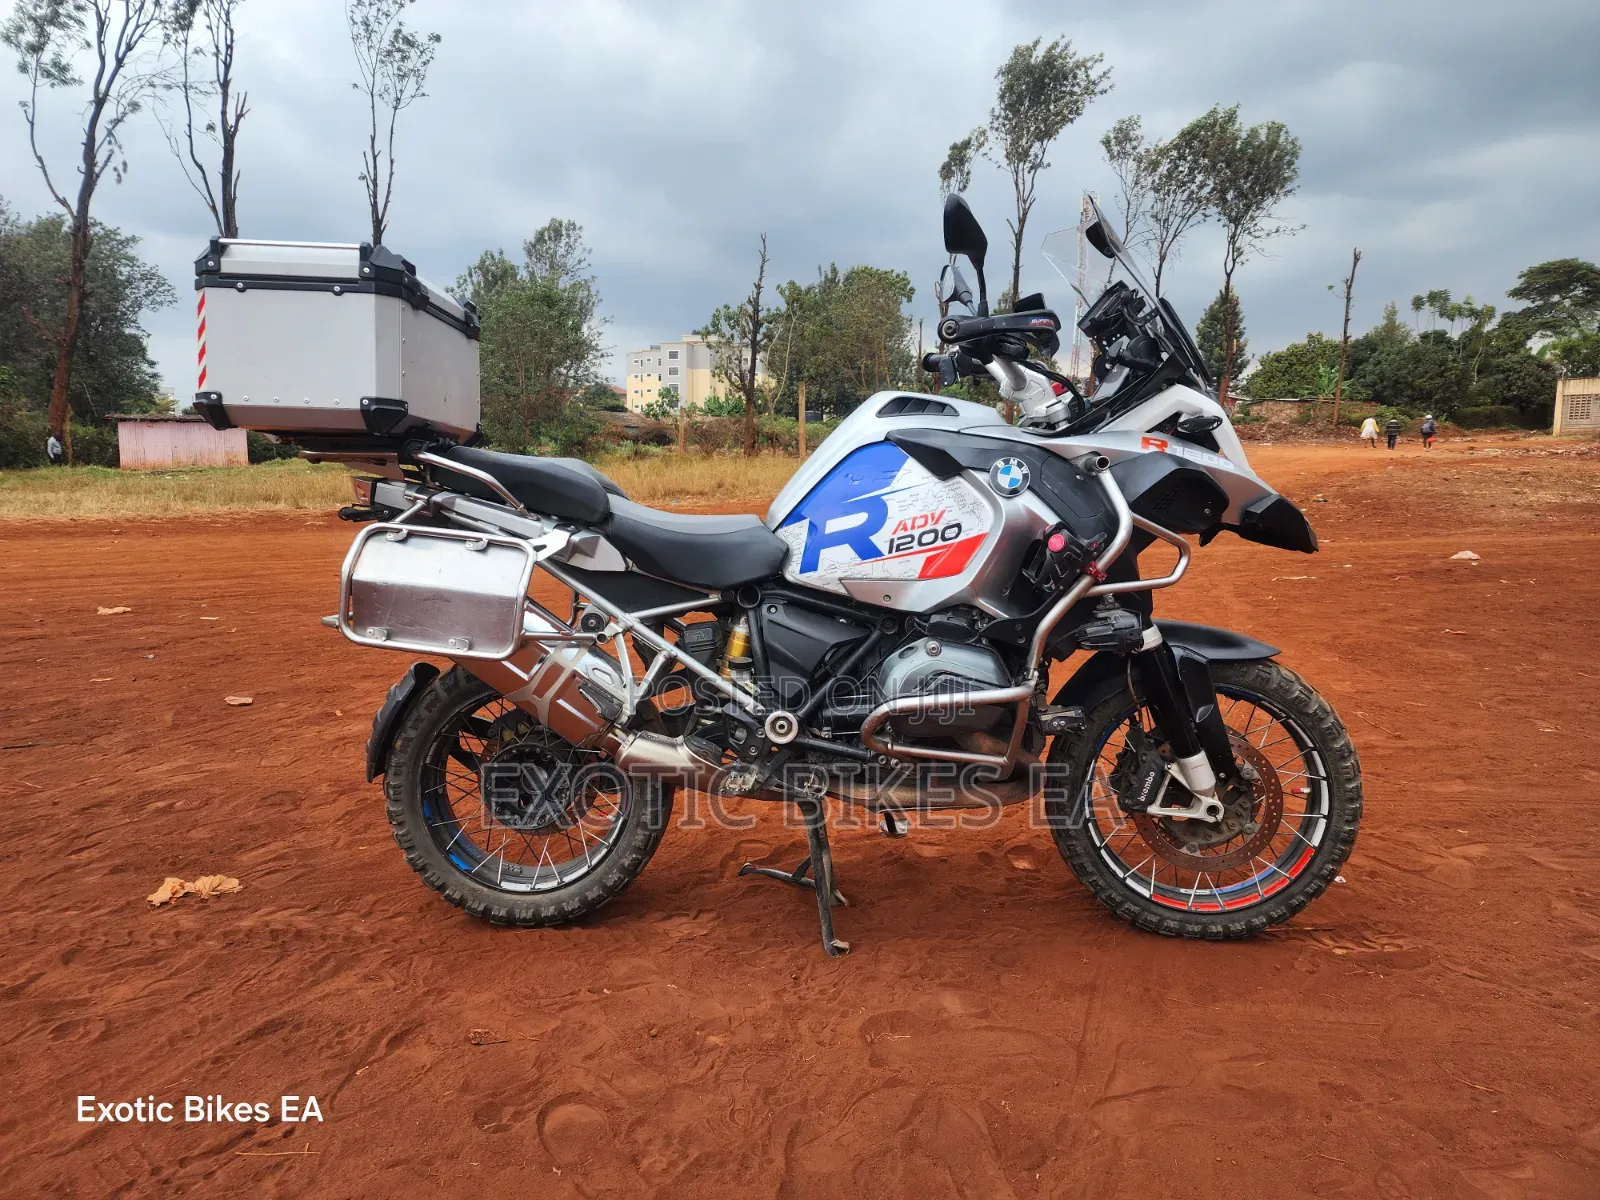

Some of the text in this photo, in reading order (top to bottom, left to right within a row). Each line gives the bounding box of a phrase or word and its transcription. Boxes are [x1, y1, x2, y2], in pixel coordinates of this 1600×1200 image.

[1141, 436, 1168, 453] R
[996, 458, 1029, 474] BMW
[891, 509, 947, 535] ADV
[888, 523, 962, 554] 1200
[1137, 771, 1155, 802] brembo
